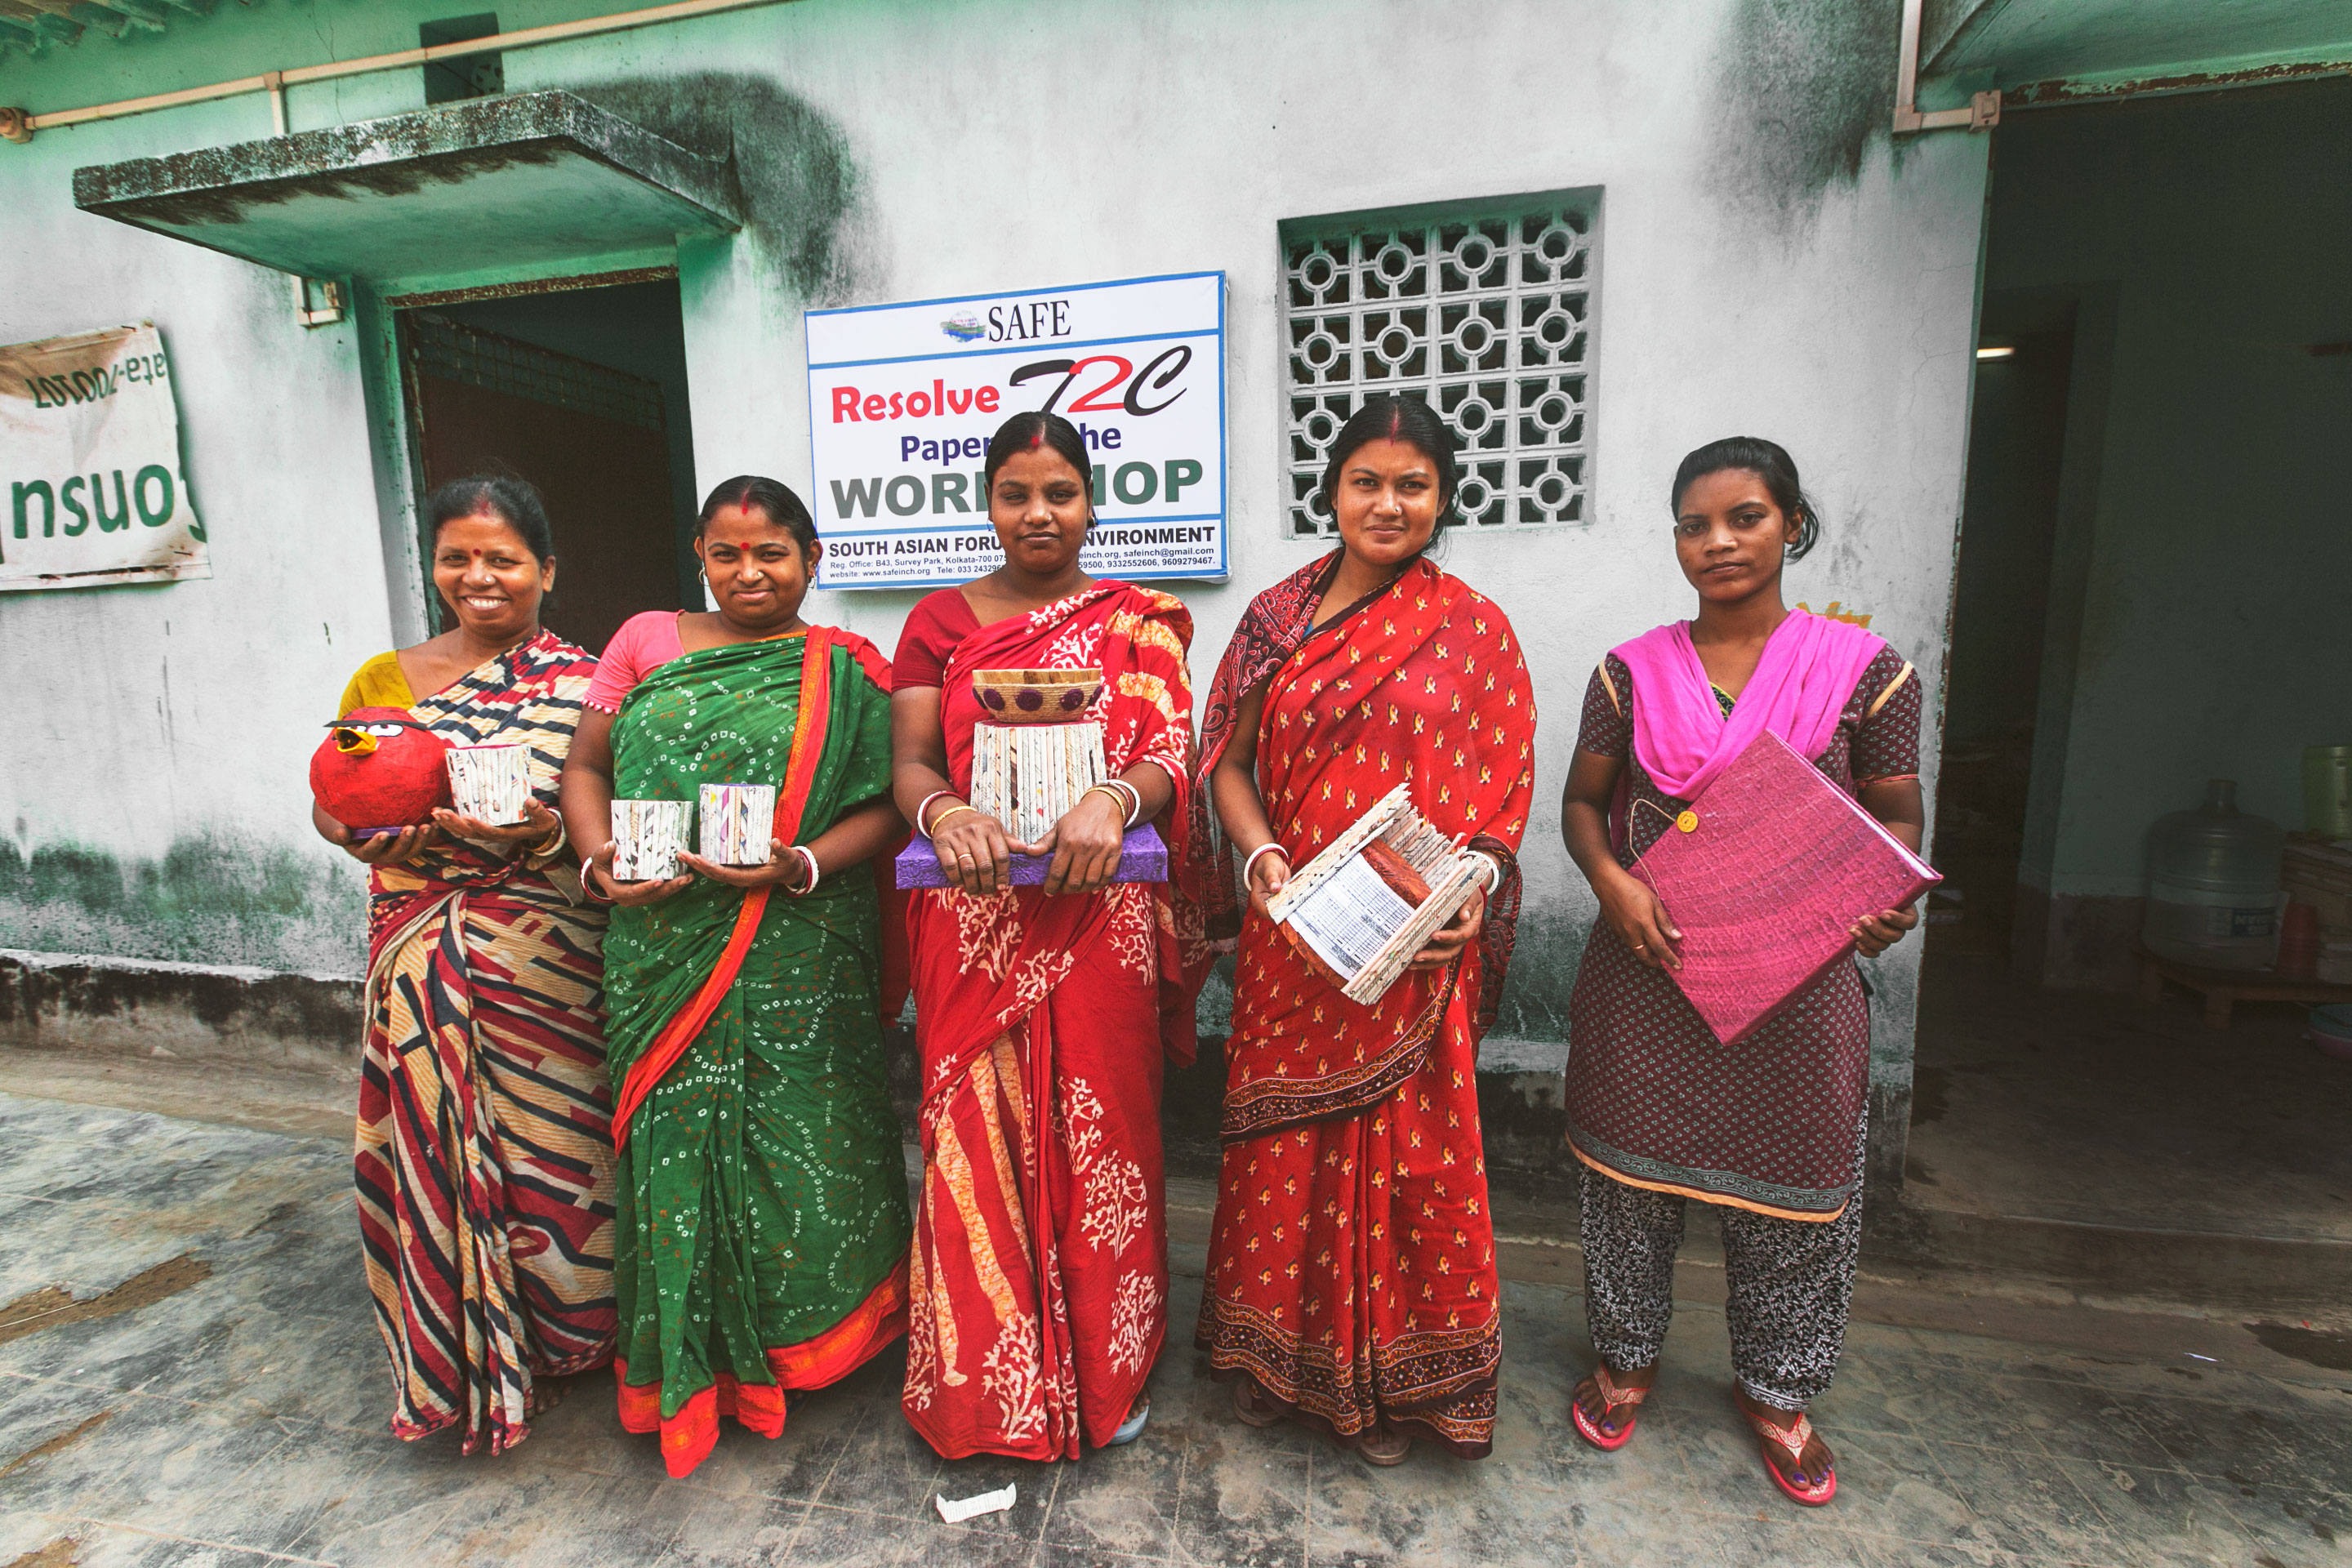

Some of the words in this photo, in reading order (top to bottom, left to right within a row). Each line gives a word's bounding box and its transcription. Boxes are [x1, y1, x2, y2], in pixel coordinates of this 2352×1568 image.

[988, 300, 1072, 342] SAFE
[24, 352, 167, 408] ata-700107
[831, 377, 1000, 424] Resolve
[829, 541, 889, 558] SOUTH
[894, 537, 948, 555] ASIAN
[955, 536, 1001, 552] FORU
[1084, 526, 1215, 546] NVIRONMENT
[849, 560, 874, 568] Office:
[894, 558, 921, 566] Survey
[946, 555, 992, 564] Kolkata-700
[1079, 551, 1121, 559] einch.org,
[1124, 547, 1214, 558] safeinch@gmail.com
[830, 570, 861, 578] website:
[862, 568, 930, 577] www.safeinch.org
[957, 565, 973, 573] 033
[1079, 560, 1105, 568] 59500,
[1107, 559, 1160, 568] 9332552606,
